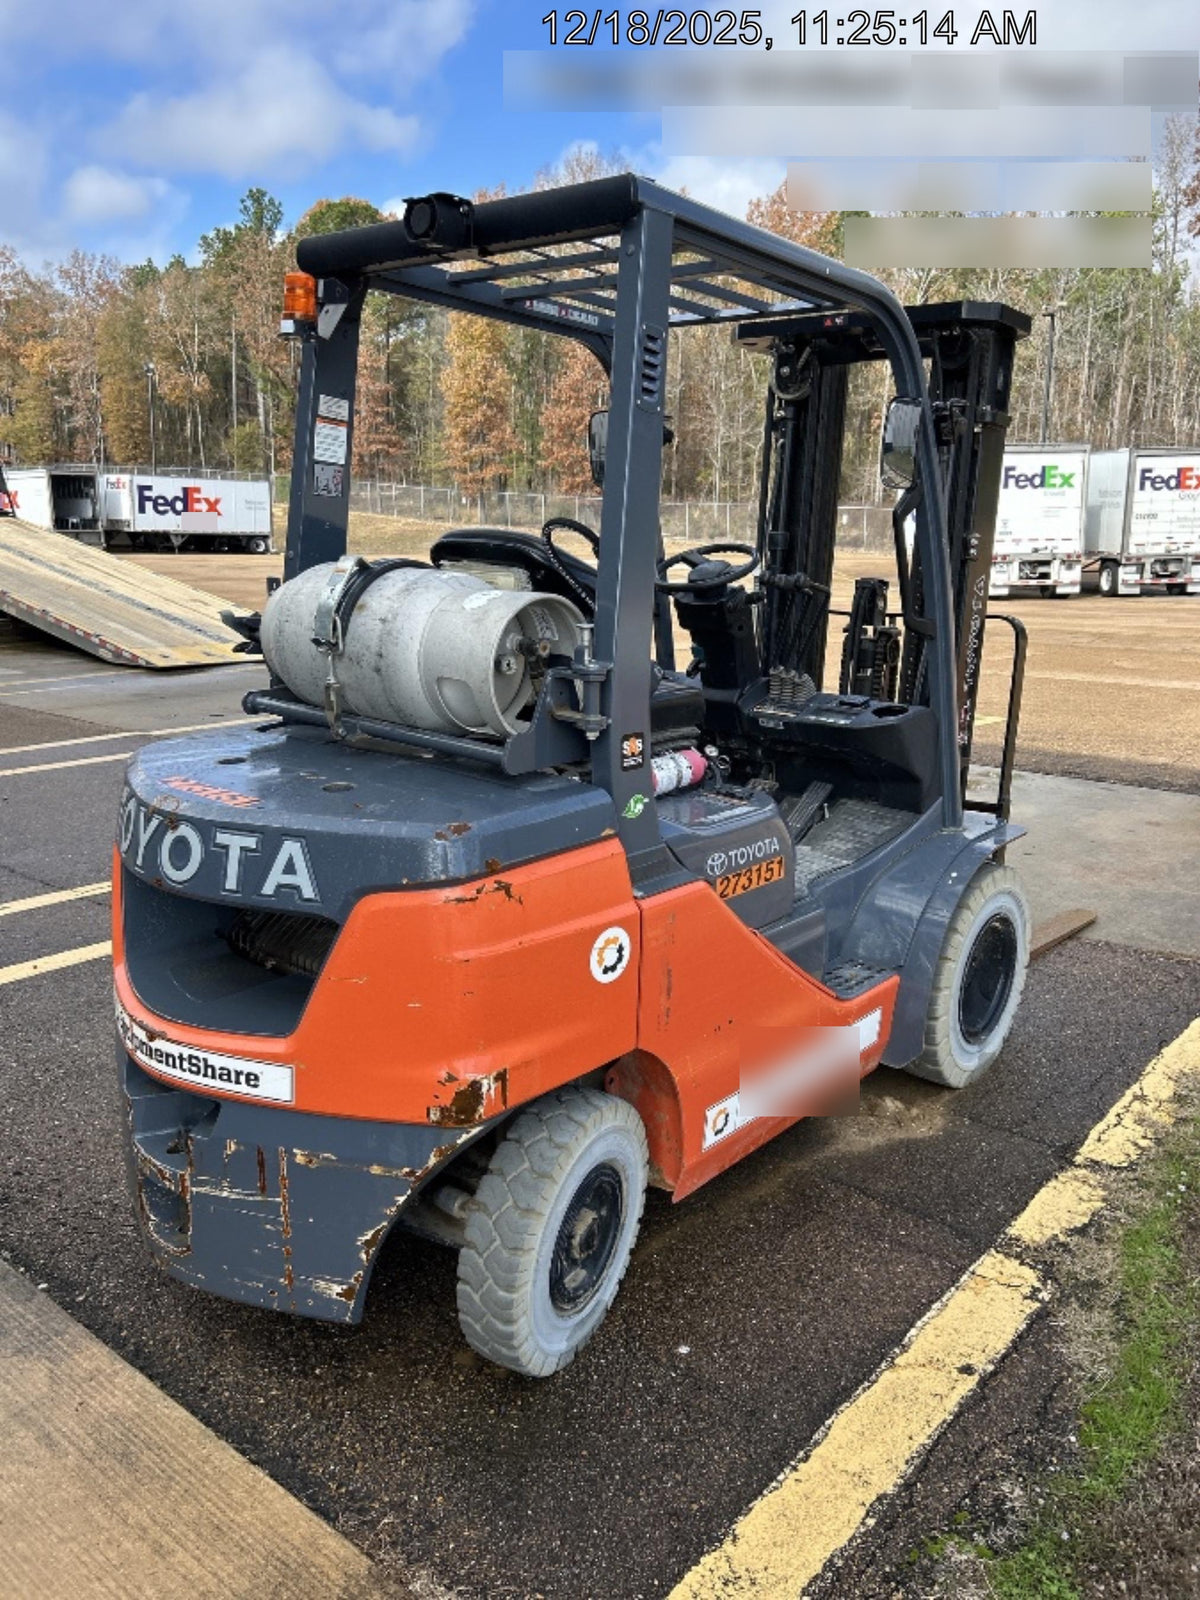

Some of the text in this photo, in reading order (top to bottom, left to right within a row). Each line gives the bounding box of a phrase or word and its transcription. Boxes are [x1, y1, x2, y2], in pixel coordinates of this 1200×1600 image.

[1003, 465, 1076, 490] FedEx
[137, 485, 223, 517] FedEx
[119, 786, 322, 903] OYOTA
[728, 836, 779, 867] TOYOTA
[719, 856, 783, 898] 273151
